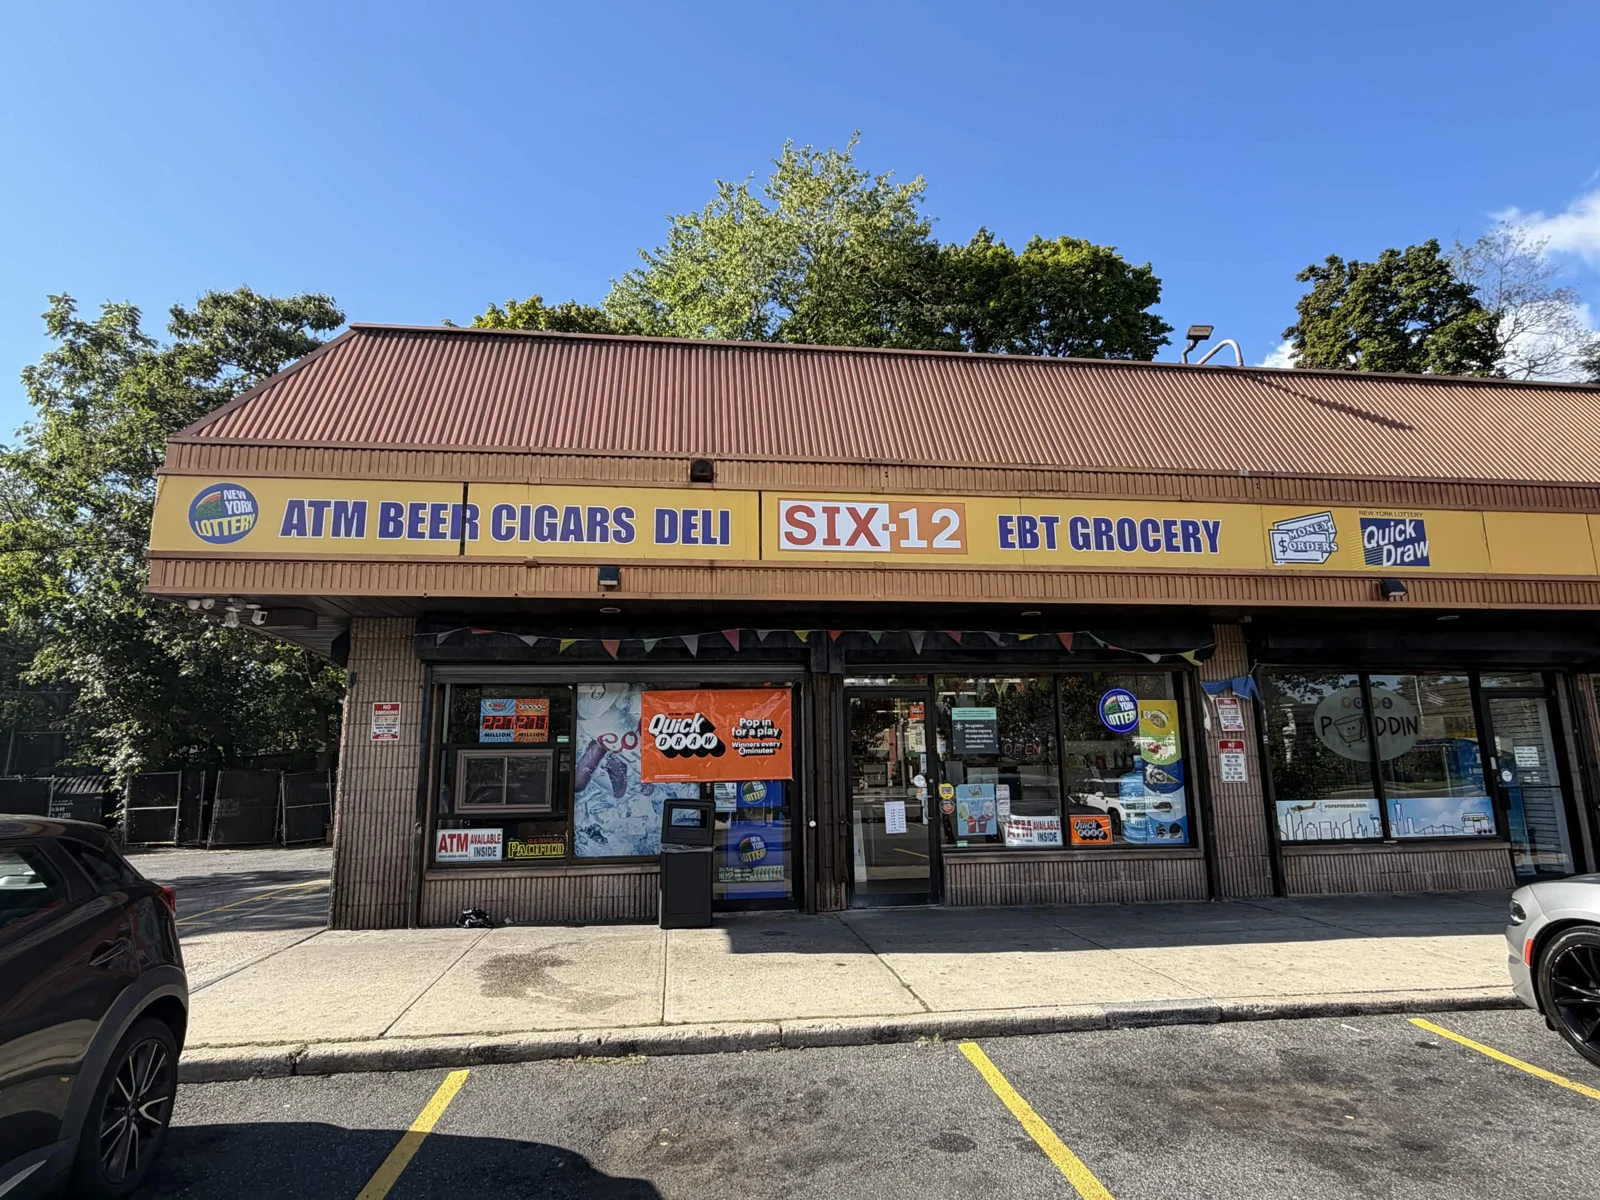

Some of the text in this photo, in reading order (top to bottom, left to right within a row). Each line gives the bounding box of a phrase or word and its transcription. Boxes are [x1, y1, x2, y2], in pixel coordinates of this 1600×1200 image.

[223, 489, 247, 500] NEW
[224, 500, 254, 515] YORK
[194, 513, 256, 537] LOTTERY
[279, 498, 731, 546] ATM BEER CIGARS DELI
[997, 514, 1222, 554] EBT GROCERY
[1288, 520, 1330, 541] MONEY
[1364, 518, 1417, 549] Quick
[1287, 541, 1339, 552] ORDERS
[1382, 539, 1429, 567] Draw
[1116, 694, 1130, 702] NEW
[1119, 701, 1135, 711] YORK
[483, 716, 548, 731] 227 271
[648, 712, 705, 737] Quick
[740, 717, 772, 728] Pop in
[1105, 710, 1136, 725] LOTTERY
[731, 726, 780, 737] for a play
[656, 734, 716, 749] DRAW
[1004, 743, 1041, 755] OPEN
[1007, 819, 1033, 838] ATM
[1033, 820, 1060, 830] AVAILABLE
[438, 833, 469, 853] ATM
[470, 833, 502, 845] AVAILABLE
[1037, 831, 1058, 843] INSIDE
[474, 846, 497, 857] INSIDE
